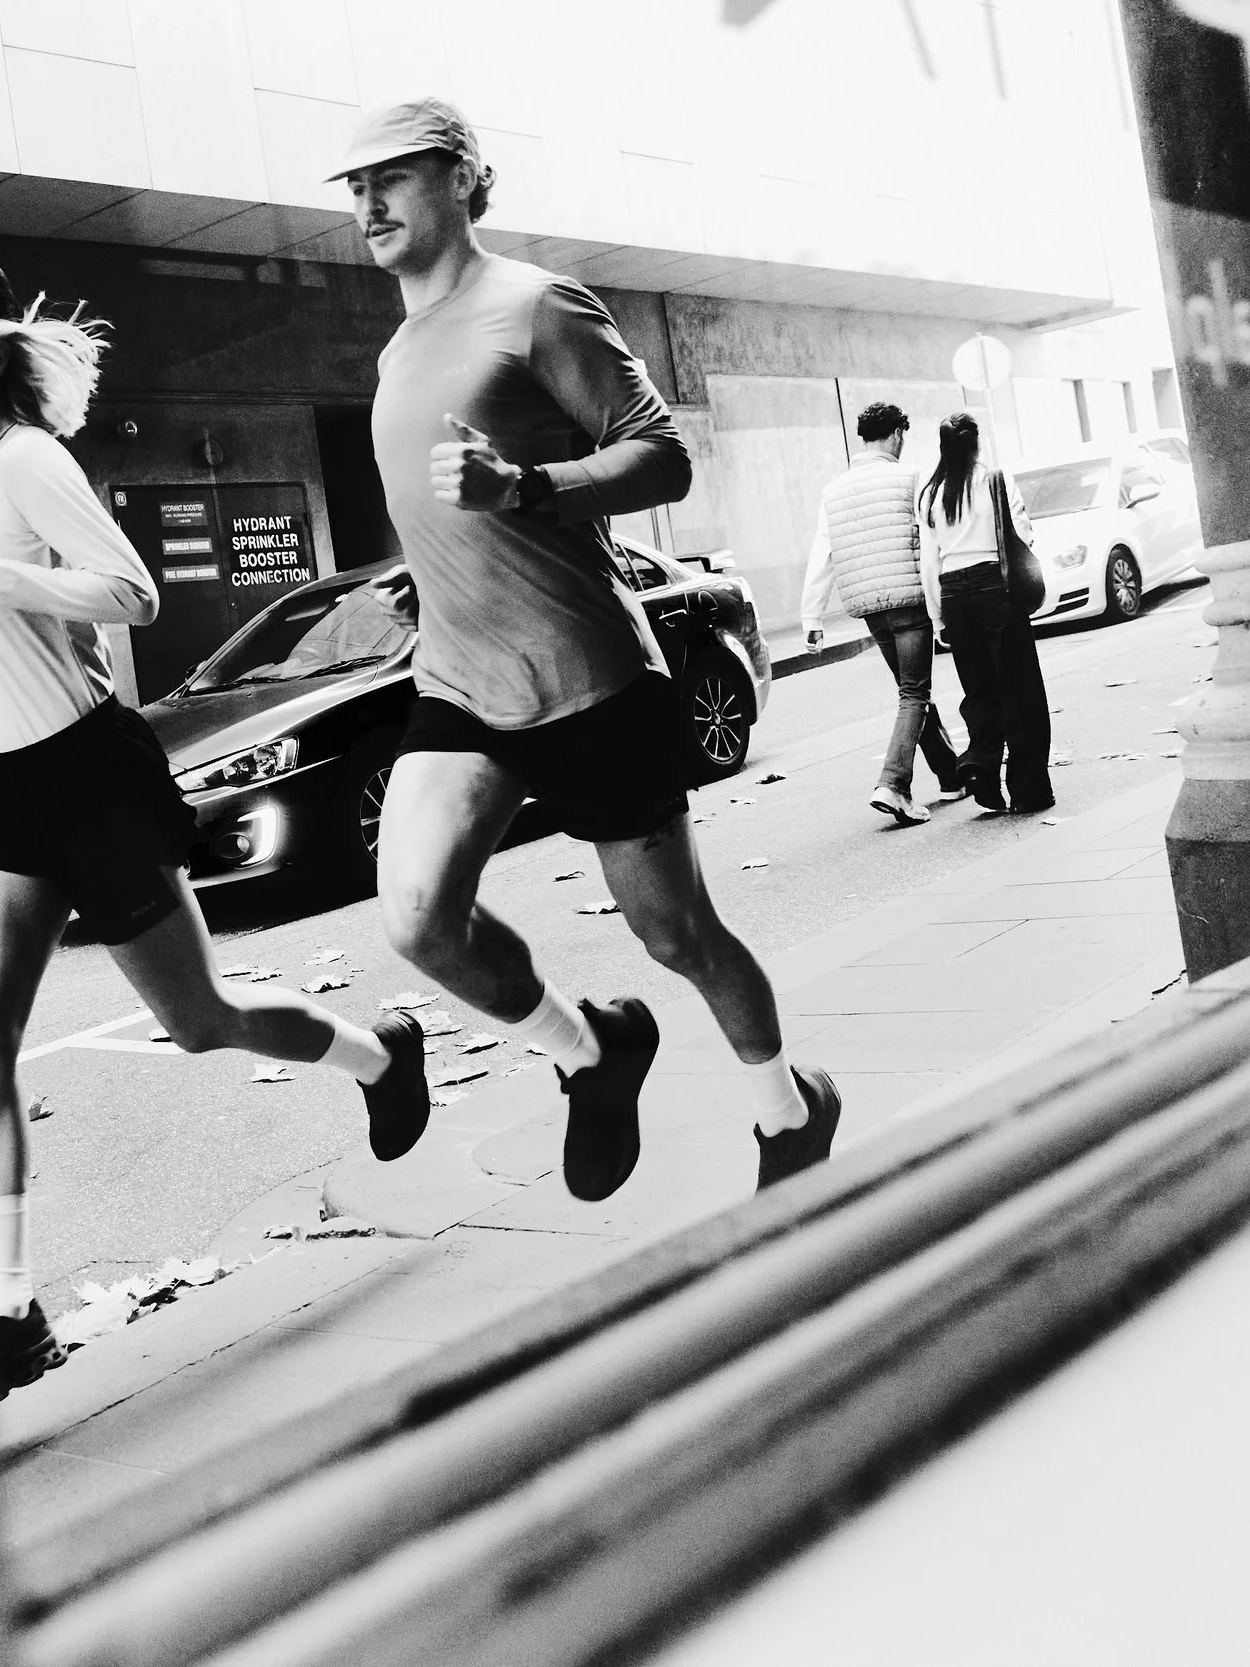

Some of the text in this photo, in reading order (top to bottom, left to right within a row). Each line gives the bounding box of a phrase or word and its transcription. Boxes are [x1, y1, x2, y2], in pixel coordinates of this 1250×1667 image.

[233, 516, 292, 532] HYDRANT
[232, 533, 299, 551] SPRINKLER
[239, 550, 298, 568] BOOSTER
[231, 567, 311, 587] CONNECTION
